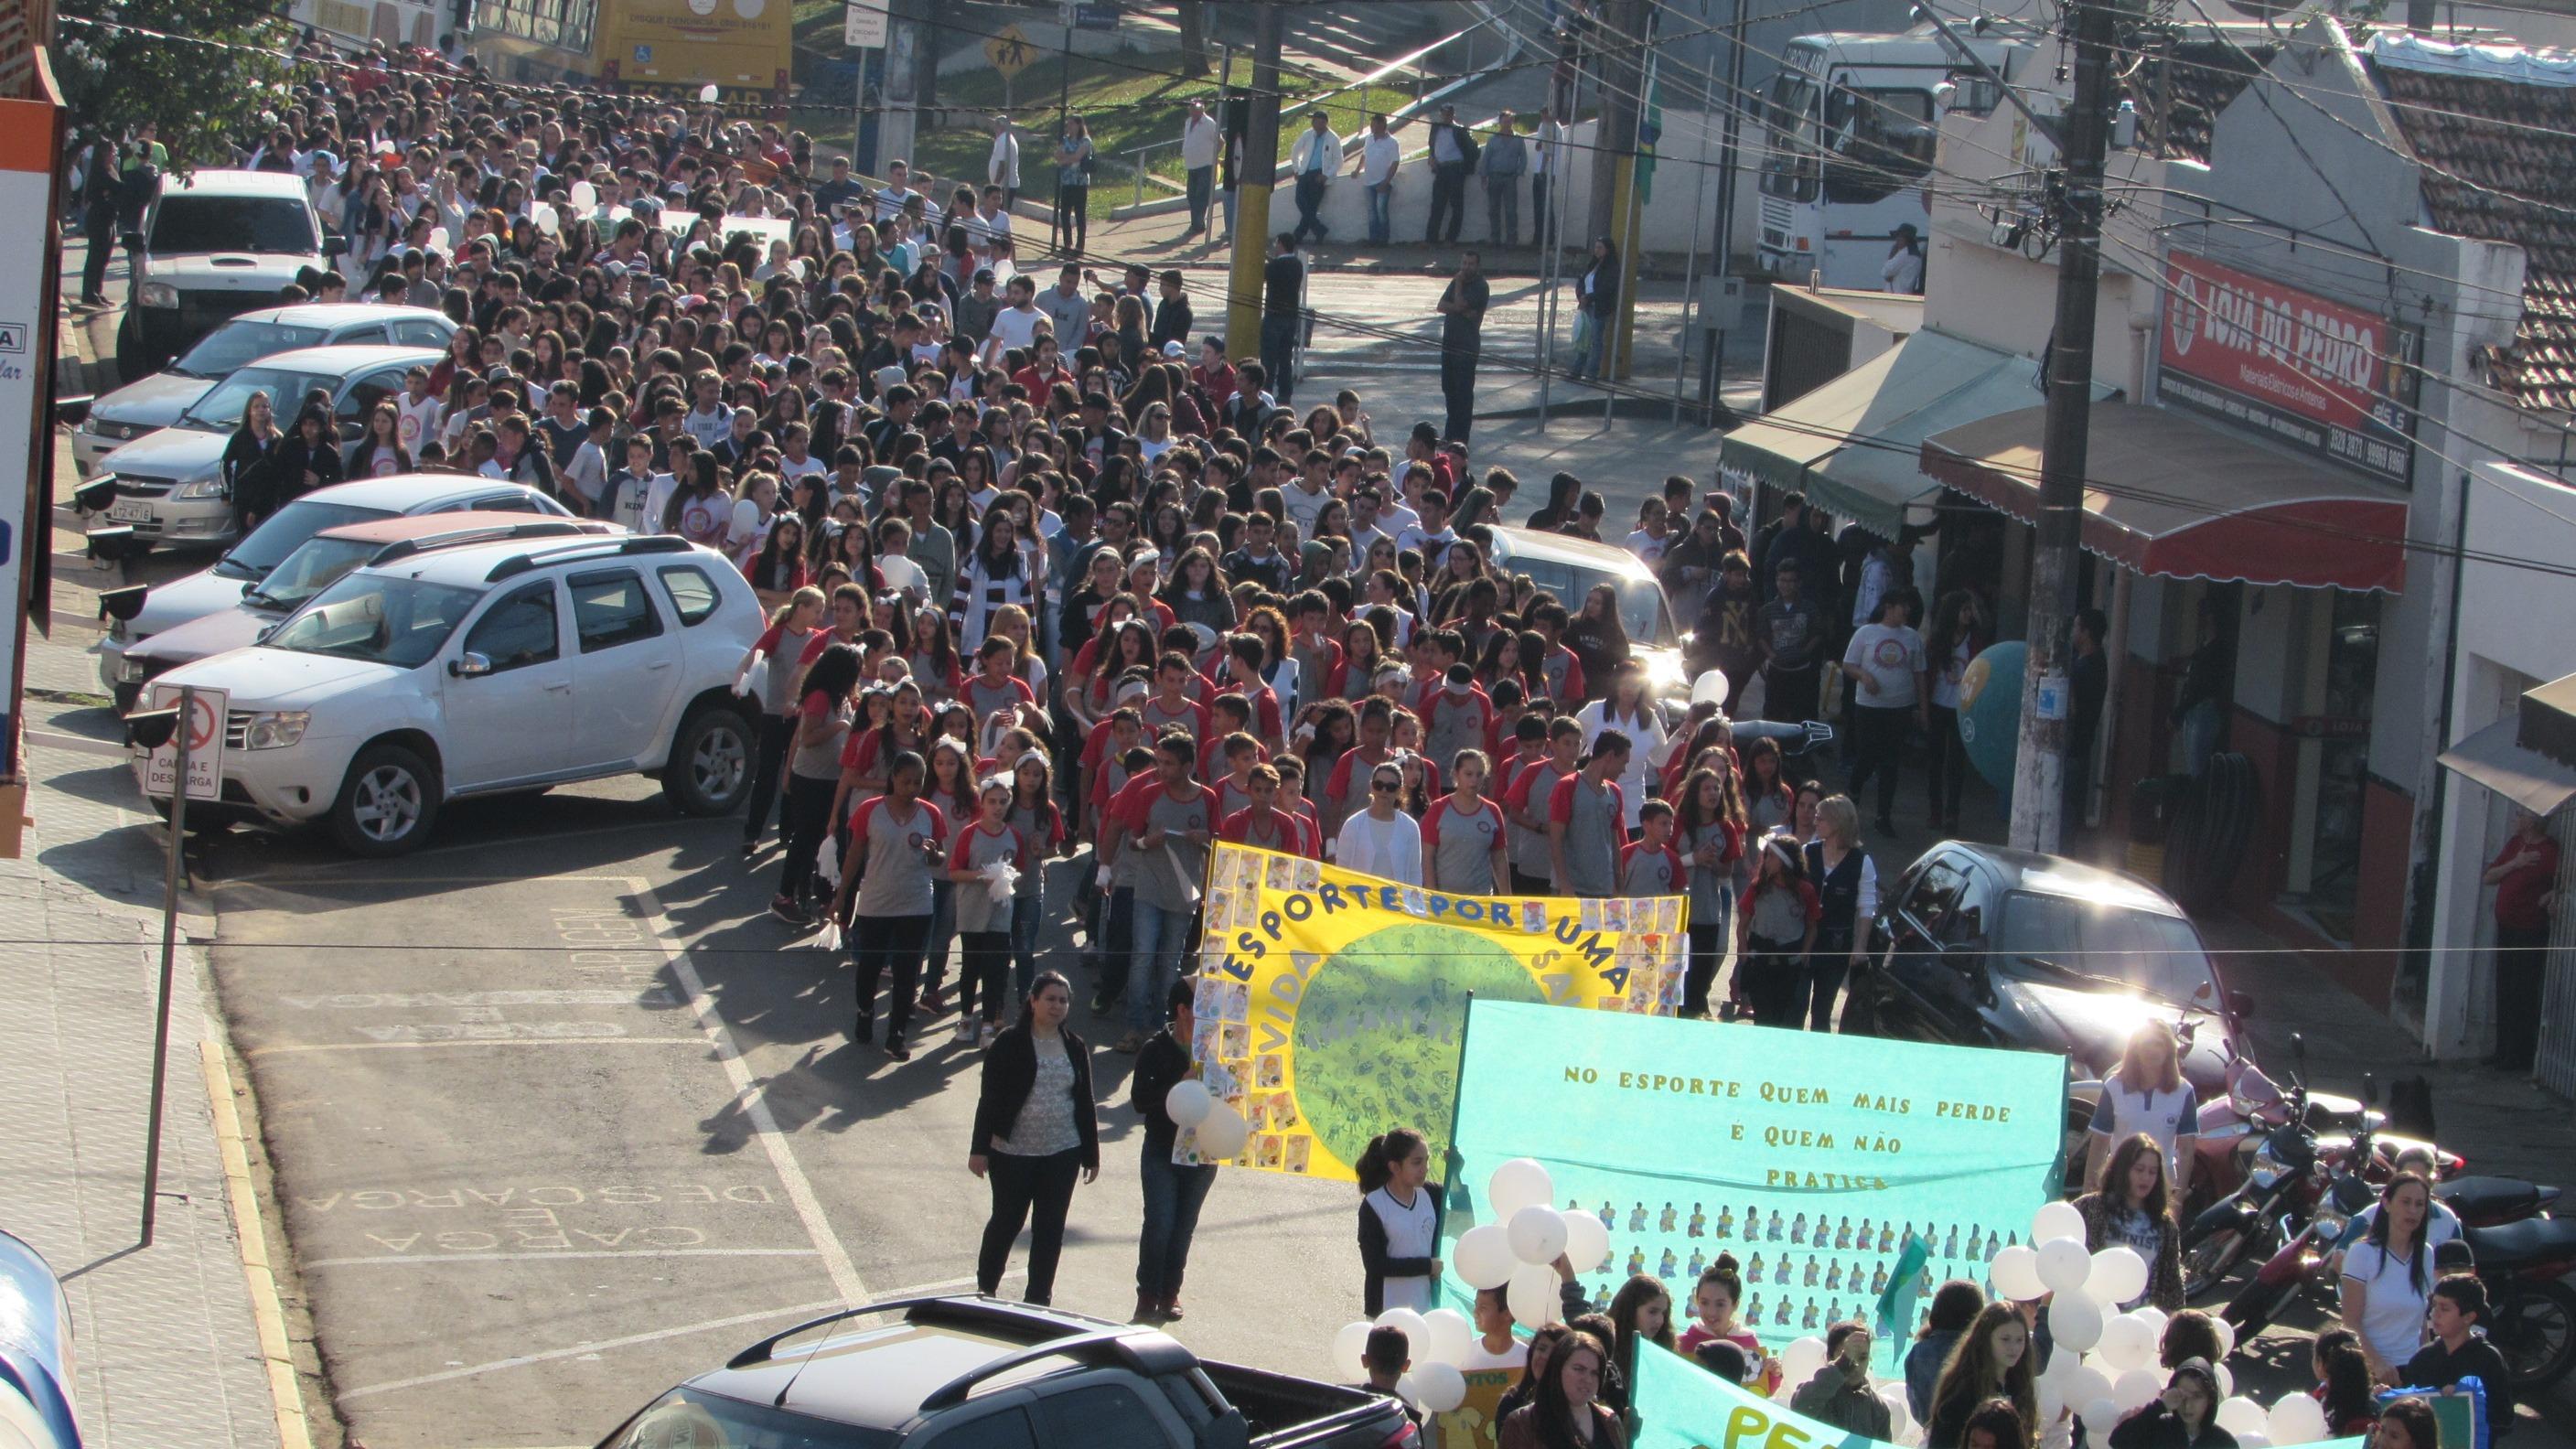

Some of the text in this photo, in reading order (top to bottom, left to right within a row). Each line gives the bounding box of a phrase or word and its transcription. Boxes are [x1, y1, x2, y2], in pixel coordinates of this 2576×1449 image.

[2205, 284, 2374, 395] LOJA DO PEDRO
[152, 773, 212, 787] DESRGA
[158, 758, 197, 770] CAA
[1223, 882, 1631, 995] ESPORTE POR UMA
[1258, 948, 1321, 1053] VIDA
[1563, 1065, 2012, 1123] NO ESPORTE QUEM MAIS PERDE
[1730, 1119, 1902, 1154] É QUEM NÃO
